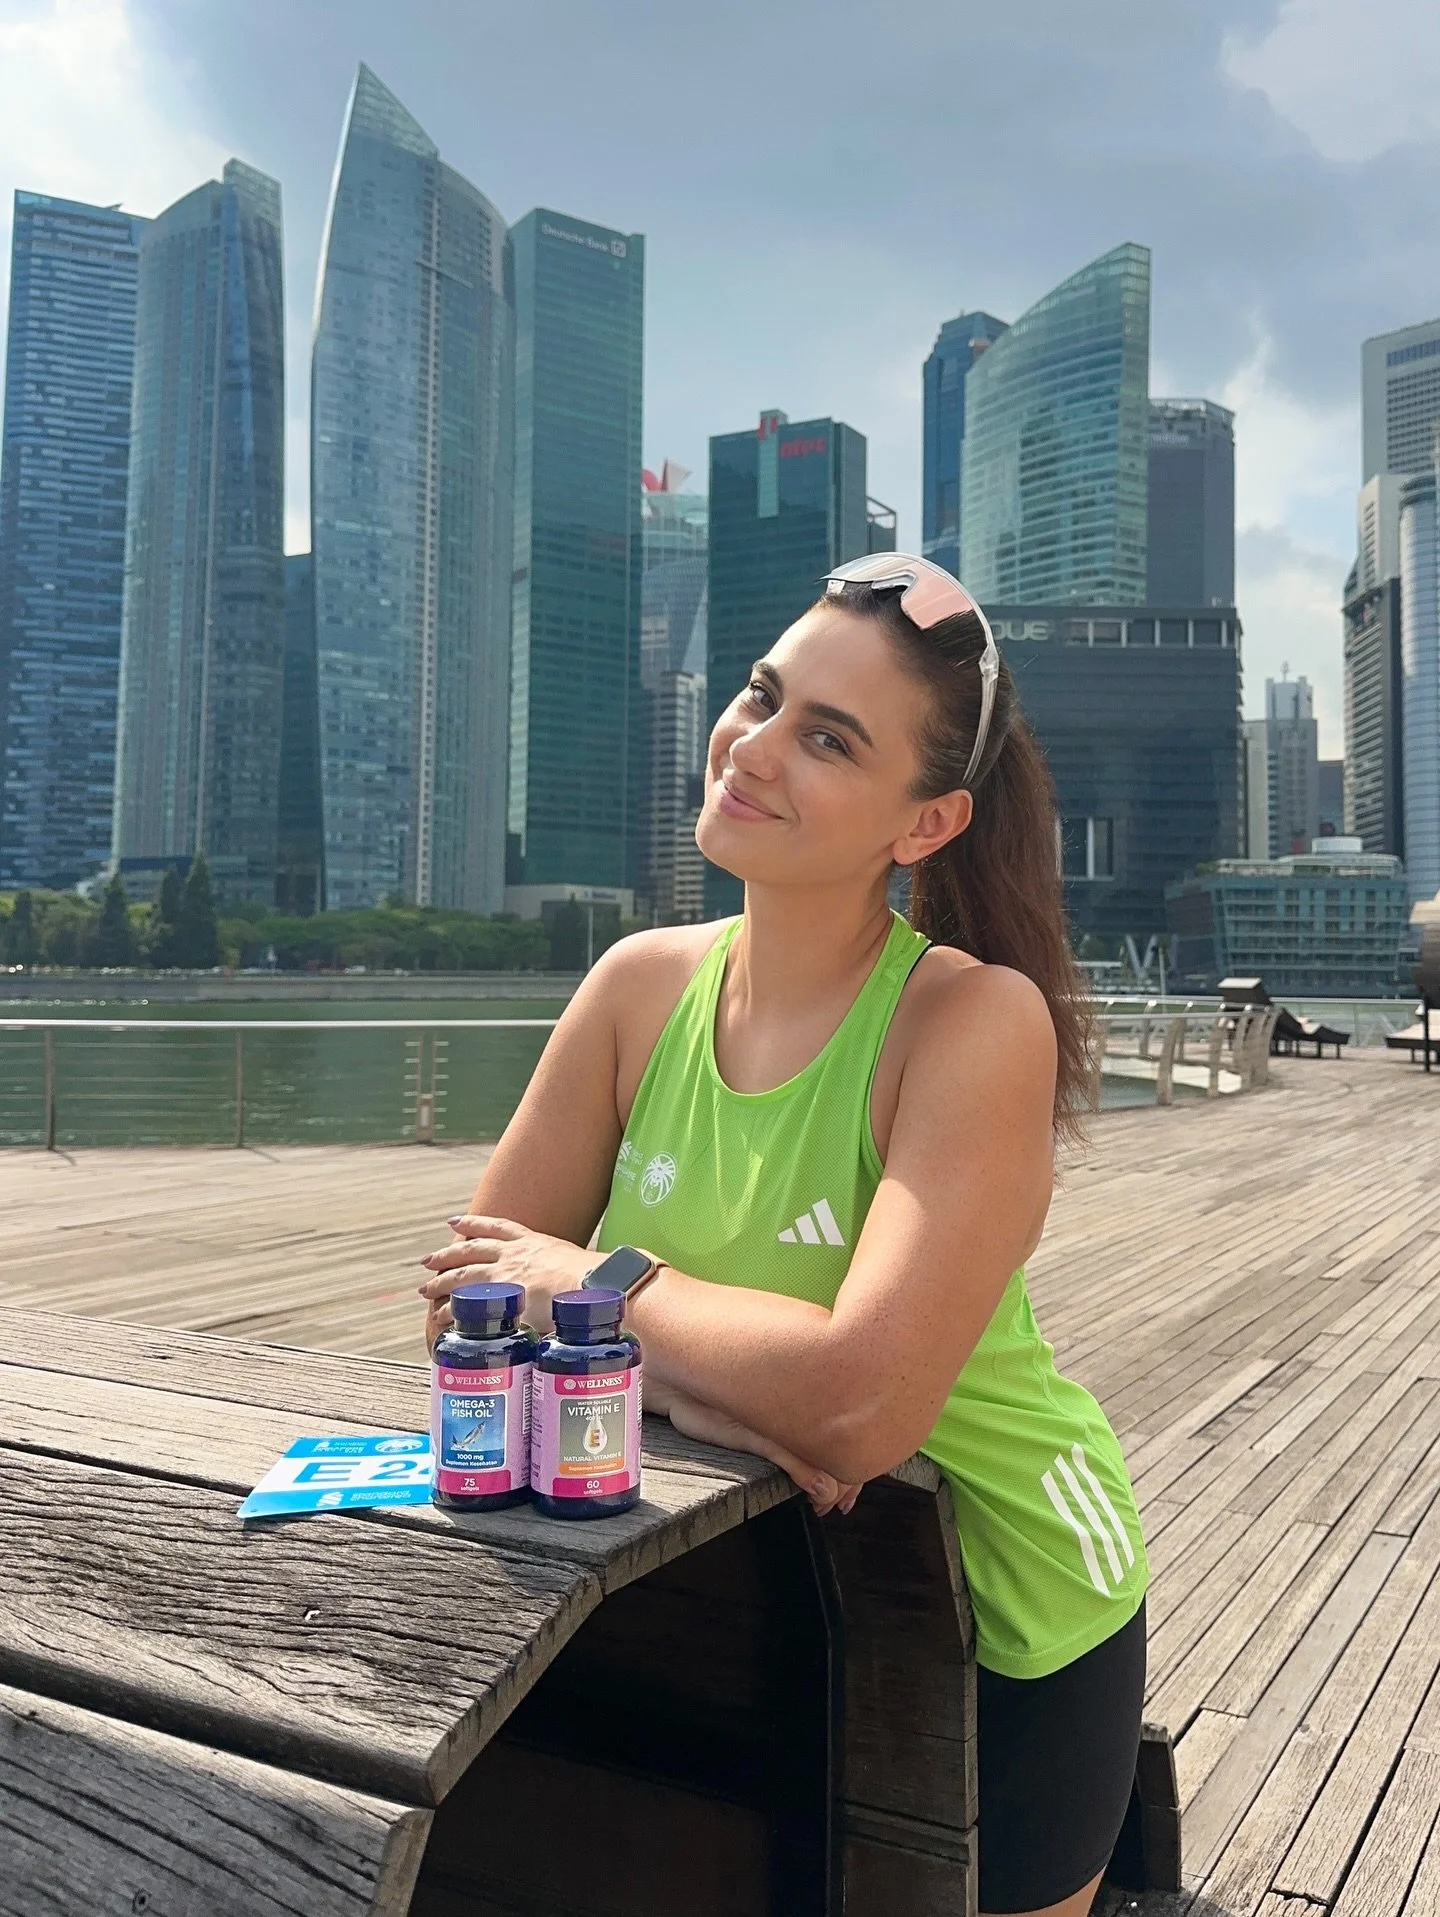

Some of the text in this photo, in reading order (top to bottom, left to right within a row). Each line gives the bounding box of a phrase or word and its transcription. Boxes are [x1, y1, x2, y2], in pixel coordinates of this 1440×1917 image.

[454, 1375, 503, 1385] WELLNESS
[577, 1376, 624, 1389] WELLNESS
[449, 1399, 495, 1408] OMEGA-3
[451, 1409, 493, 1418] FISH OIL
[567, 1403, 620, 1416] VITAMIN E
[593, 1452, 617, 1461] VITAMIN
[464, 1478, 476, 1486] 75
[586, 1480, 600, 1489] 60
